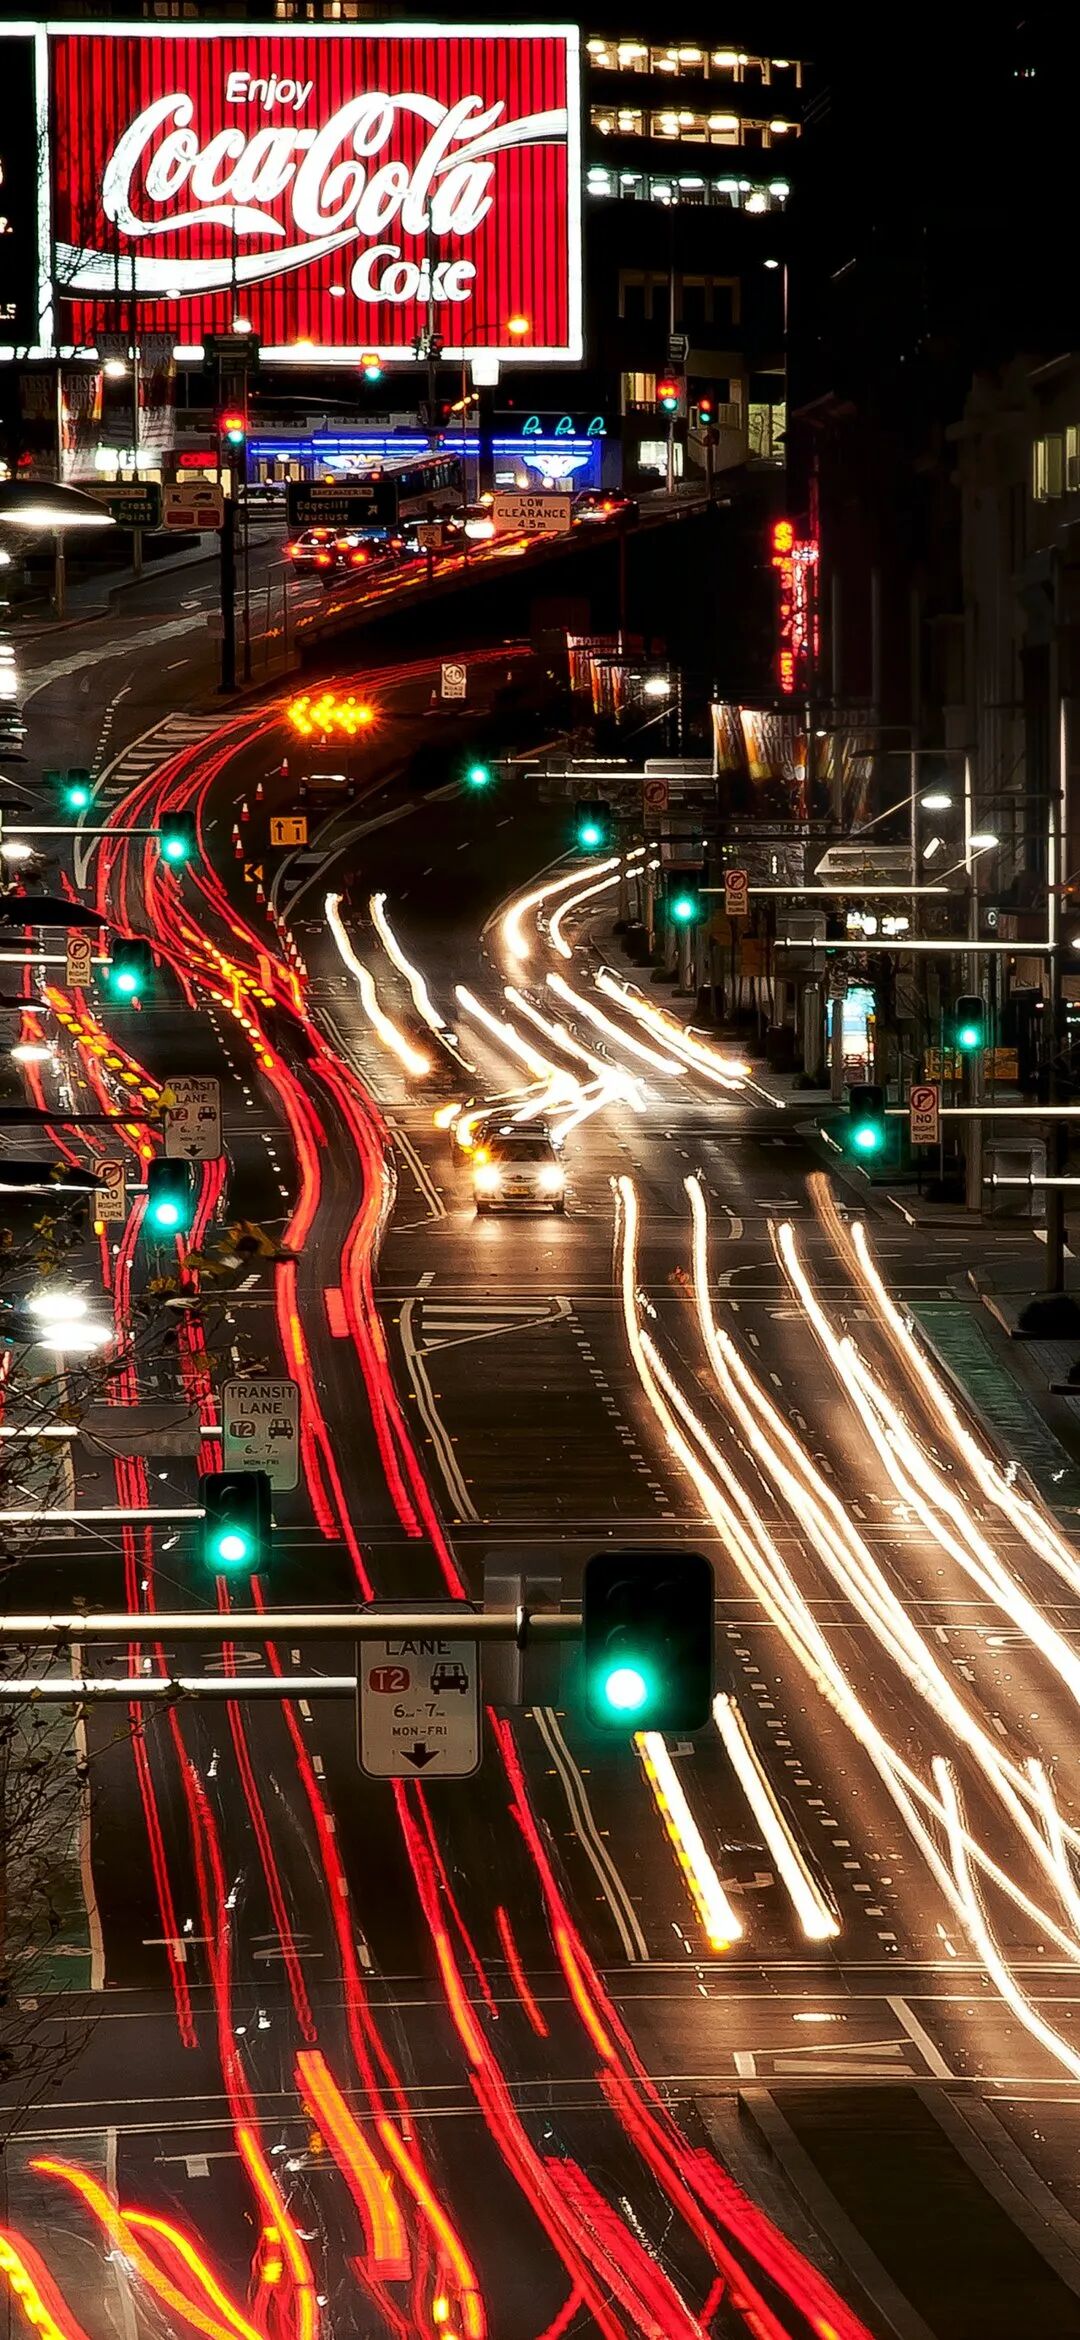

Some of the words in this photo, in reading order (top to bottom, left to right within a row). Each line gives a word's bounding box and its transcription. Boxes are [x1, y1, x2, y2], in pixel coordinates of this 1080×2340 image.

[226, 71, 313, 111] Enjoy
[103, 92, 505, 236] Coca-Cola
[350, 244, 477, 302] Coke
[120, 502, 153, 511] Cross
[296, 501, 349, 512] Edgecliff
[520, 498, 543, 507] LOW
[119, 513, 151, 521] Point
[296, 512, 349, 521] Vaucluse
[497, 508, 566, 519] CLEARANCE
[517, 519, 546, 529] 4.5m
[446, 669, 461, 680] 40
[71, 961, 86, 970] NO
[167, 1081, 218, 1092] TRANSIT
[176, 1093, 209, 1103] LANE
[916, 1114, 931, 1123] NO
[101, 1189, 118, 1199] NO
[98, 1201, 122, 1209] RIGHT
[99, 1210, 121, 1218] TURN
[228, 1386, 295, 1398] TRANSIT
[240, 1402, 283, 1414] LANE
[233, 1423, 252, 1436] T2
[386, 1640, 451, 1655] LANE
[375, 1669, 405, 1690] T2
[392, 1726, 447, 1736] MON-FRI
